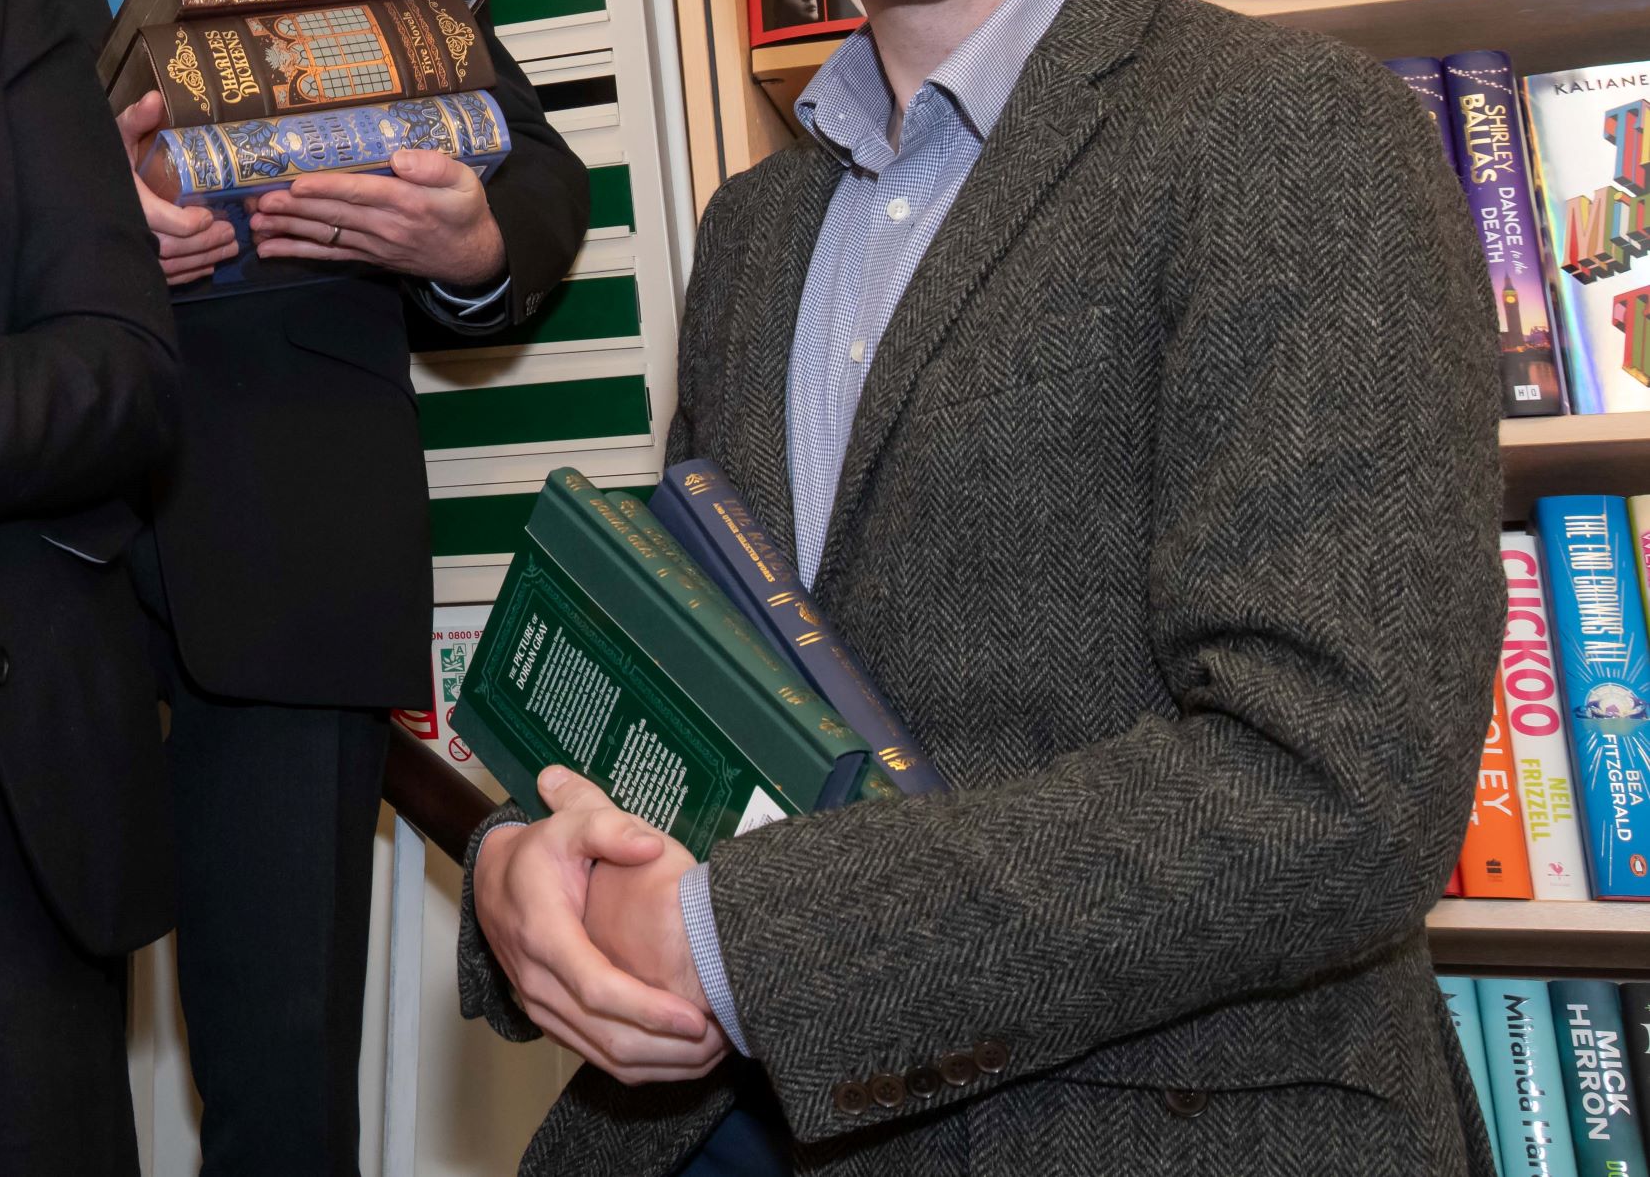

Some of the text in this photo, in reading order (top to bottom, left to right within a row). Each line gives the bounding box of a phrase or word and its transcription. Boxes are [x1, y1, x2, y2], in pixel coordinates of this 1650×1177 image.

[205, 30, 240, 106] CHARLES
[222, 31, 260, 100] DICKENS
[404, 12, 434, 77] Five Novels
[1555, 74, 1650, 96] KALIANE
[1459, 93, 1497, 184] BALLAS
[1484, 105, 1515, 172] SHIRLEY
[1480, 207, 1505, 264] DEATH
[1498, 187, 1523, 246] DANCE
[722, 512, 737, 535] OTHER
[734, 530, 759, 561] SELECTED
[756, 559, 775, 582] WORKS
[1564, 515, 1627, 665] THE END CROWNS ALL
[448, 631, 471, 639] 0800
[513, 621, 535, 667] PICTURE
[529, 613, 538, 621] OF
[515, 620, 548, 691] DORIAN GRAY
[1500, 549, 1560, 737] CUCKOO
[1520, 758, 1549, 842] FRIZZELL
[1548, 777, 1574, 822] NELL
[1602, 733, 1632, 841] FITZGERALD
[1625, 769, 1644, 805] BEA
[1503, 994, 1545, 1111] Miranda
[1566, 1004, 1610, 1141] HERRON
[1595, 1031, 1631, 1116] MICK
